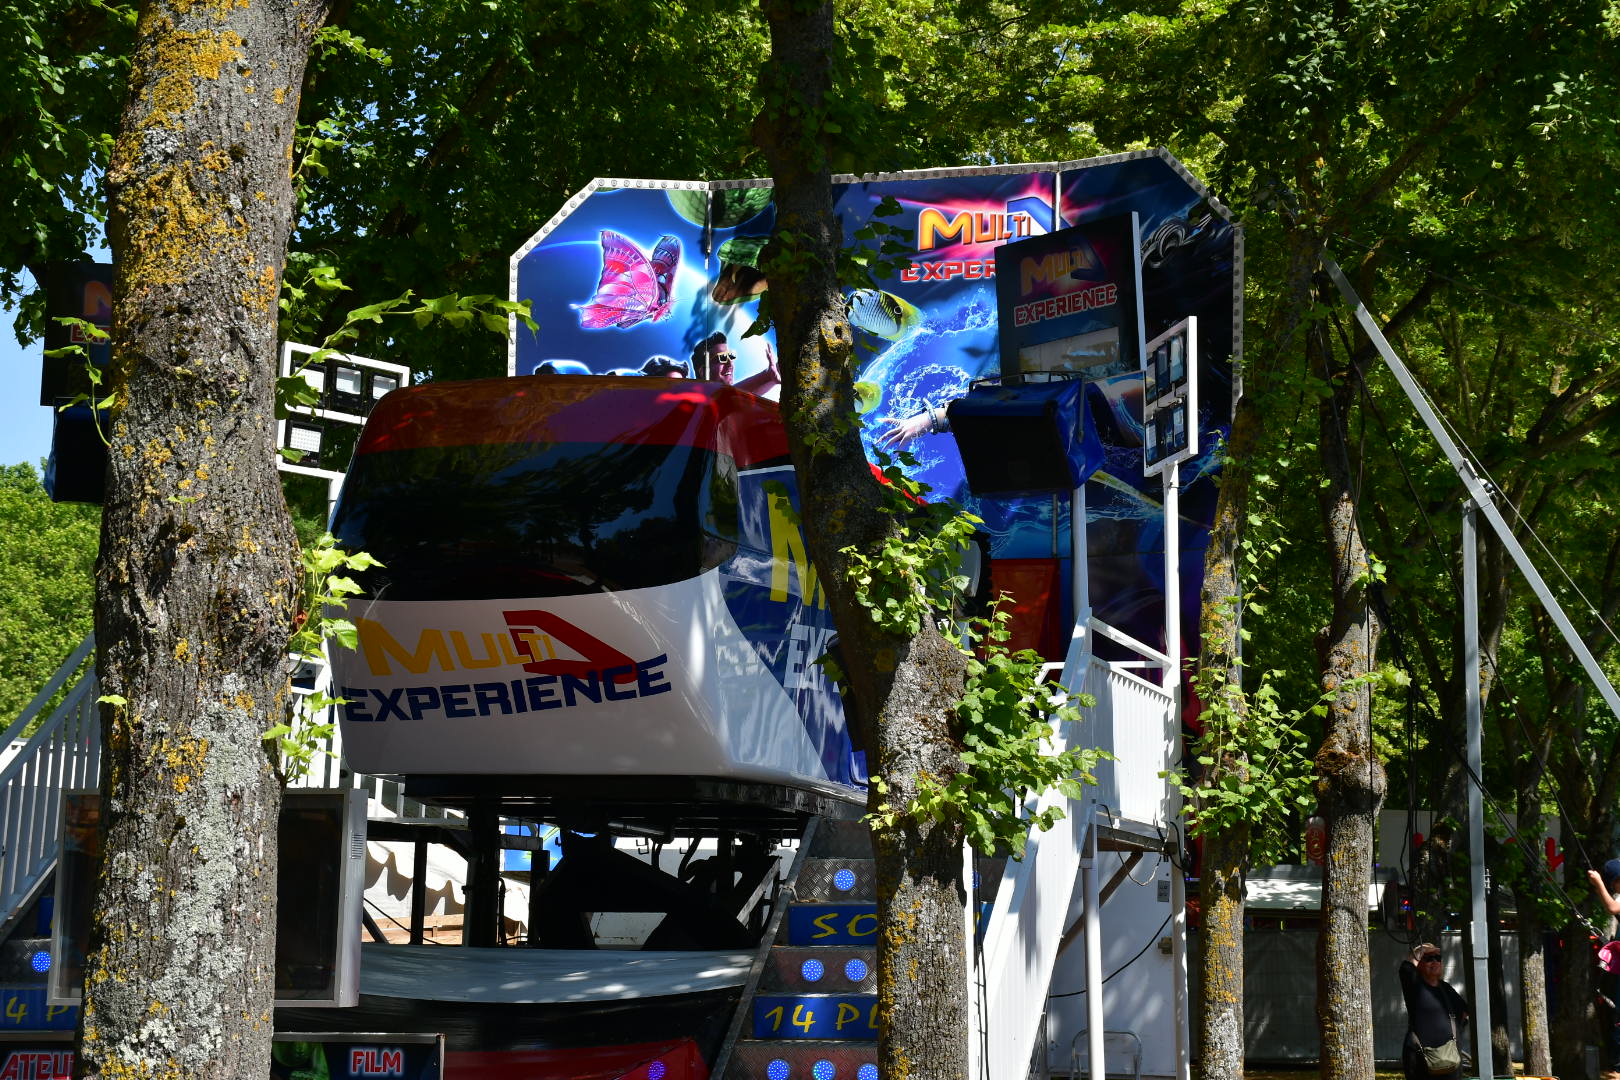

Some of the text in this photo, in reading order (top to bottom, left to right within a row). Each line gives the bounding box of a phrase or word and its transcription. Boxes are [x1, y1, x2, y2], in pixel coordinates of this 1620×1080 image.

[1013, 283, 1118, 327] EXPERIENCE
[341, 653, 672, 722] EXPERIENCE
[764, 1003, 817, 1033] 14
[351, 1050, 402, 1075] FILM
